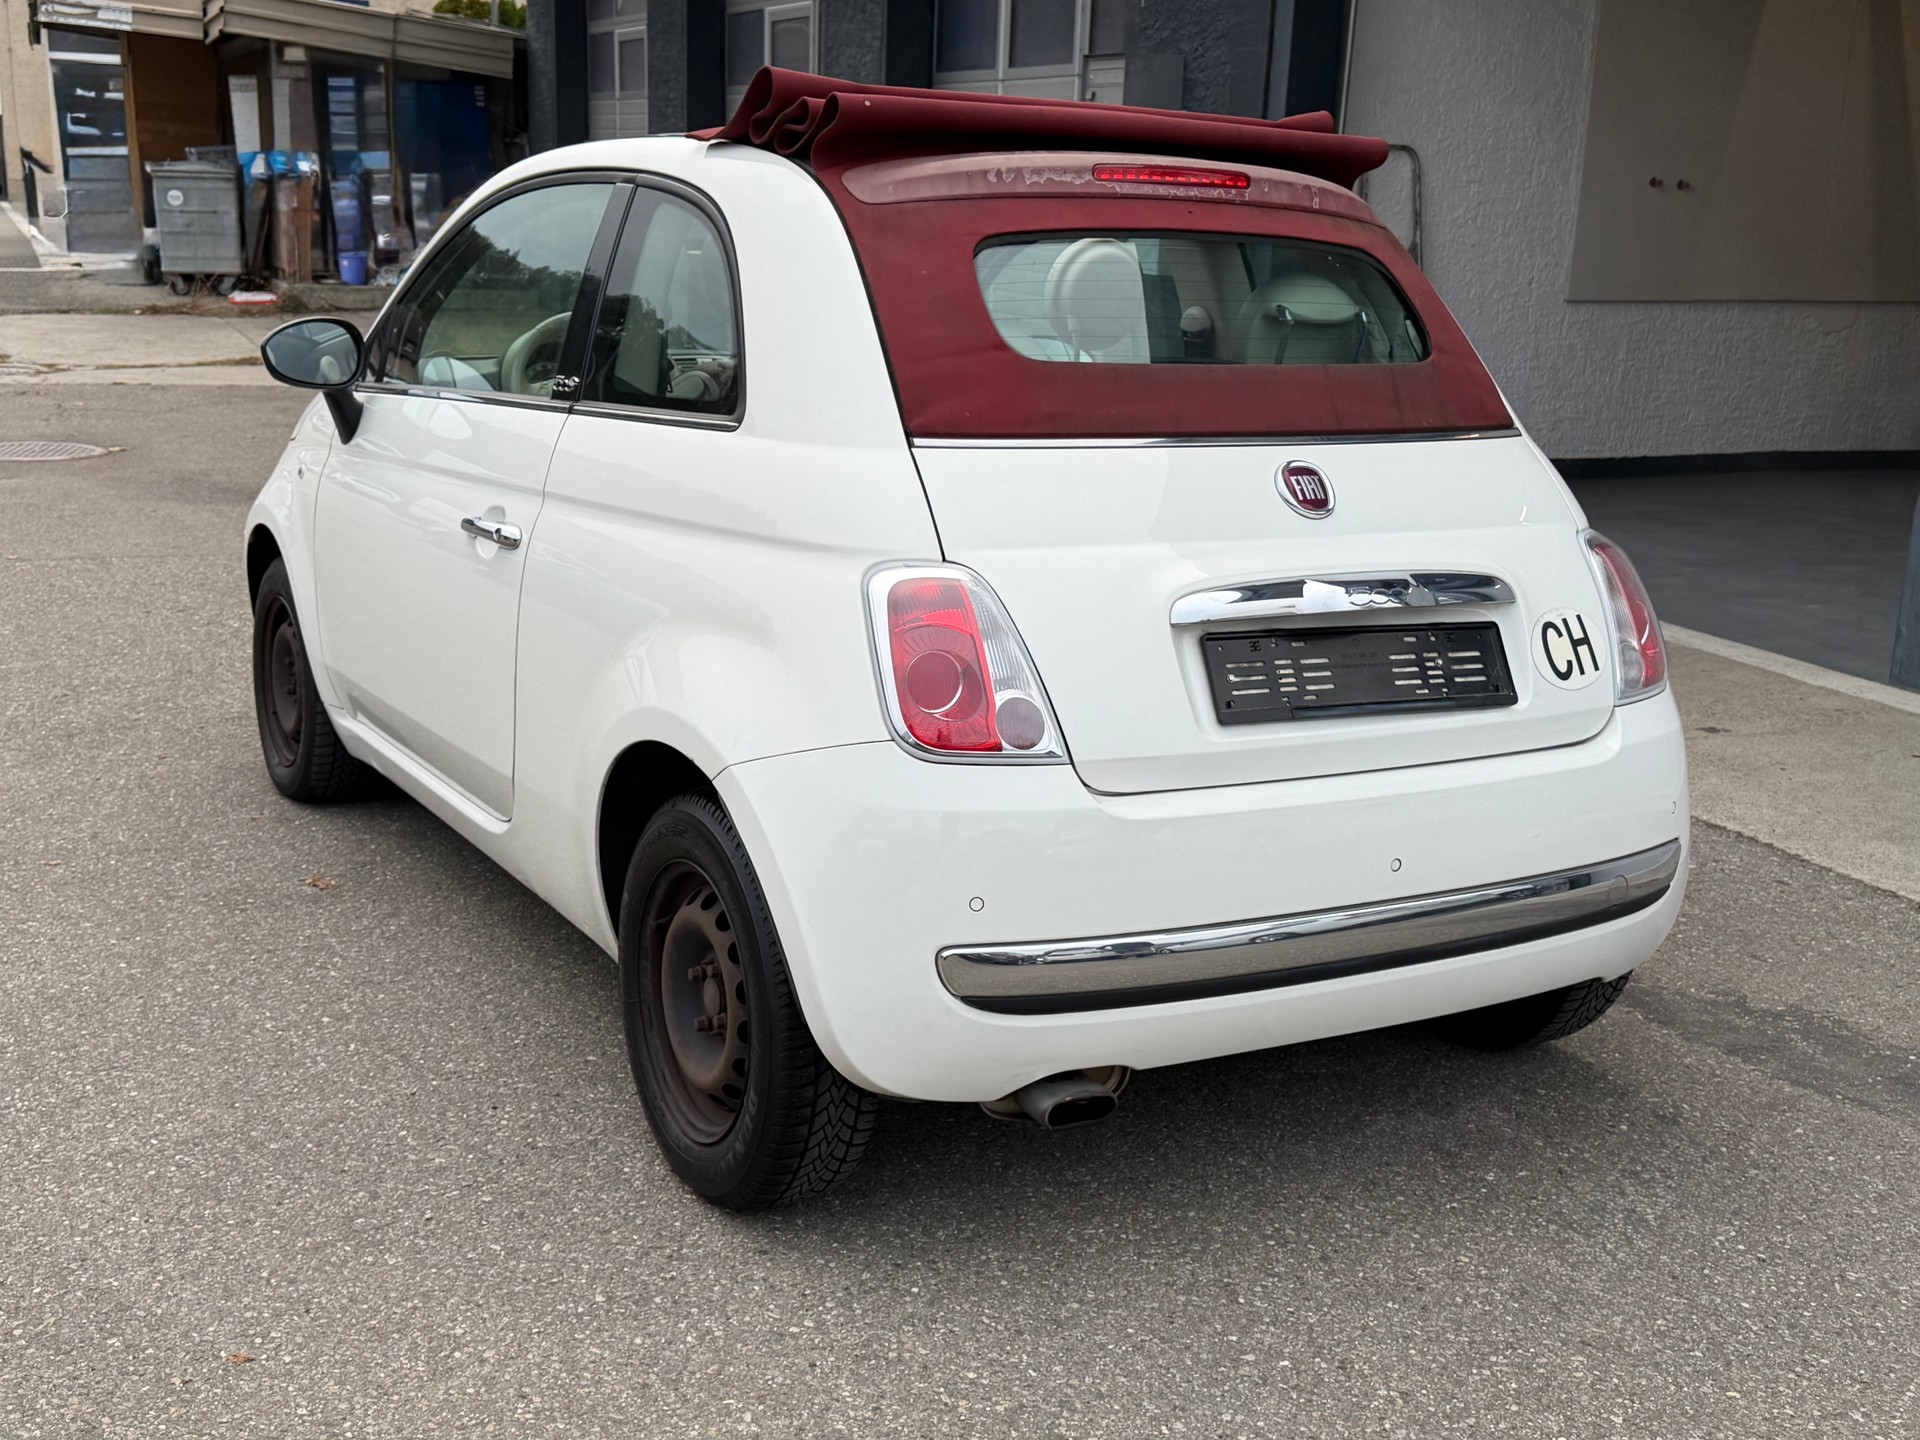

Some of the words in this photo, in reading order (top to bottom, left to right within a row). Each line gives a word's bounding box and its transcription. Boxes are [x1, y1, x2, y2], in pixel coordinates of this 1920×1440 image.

[1290, 475, 1326, 501] FIAT
[1348, 586, 1412, 607] 500
[1541, 613, 1600, 681] CH
